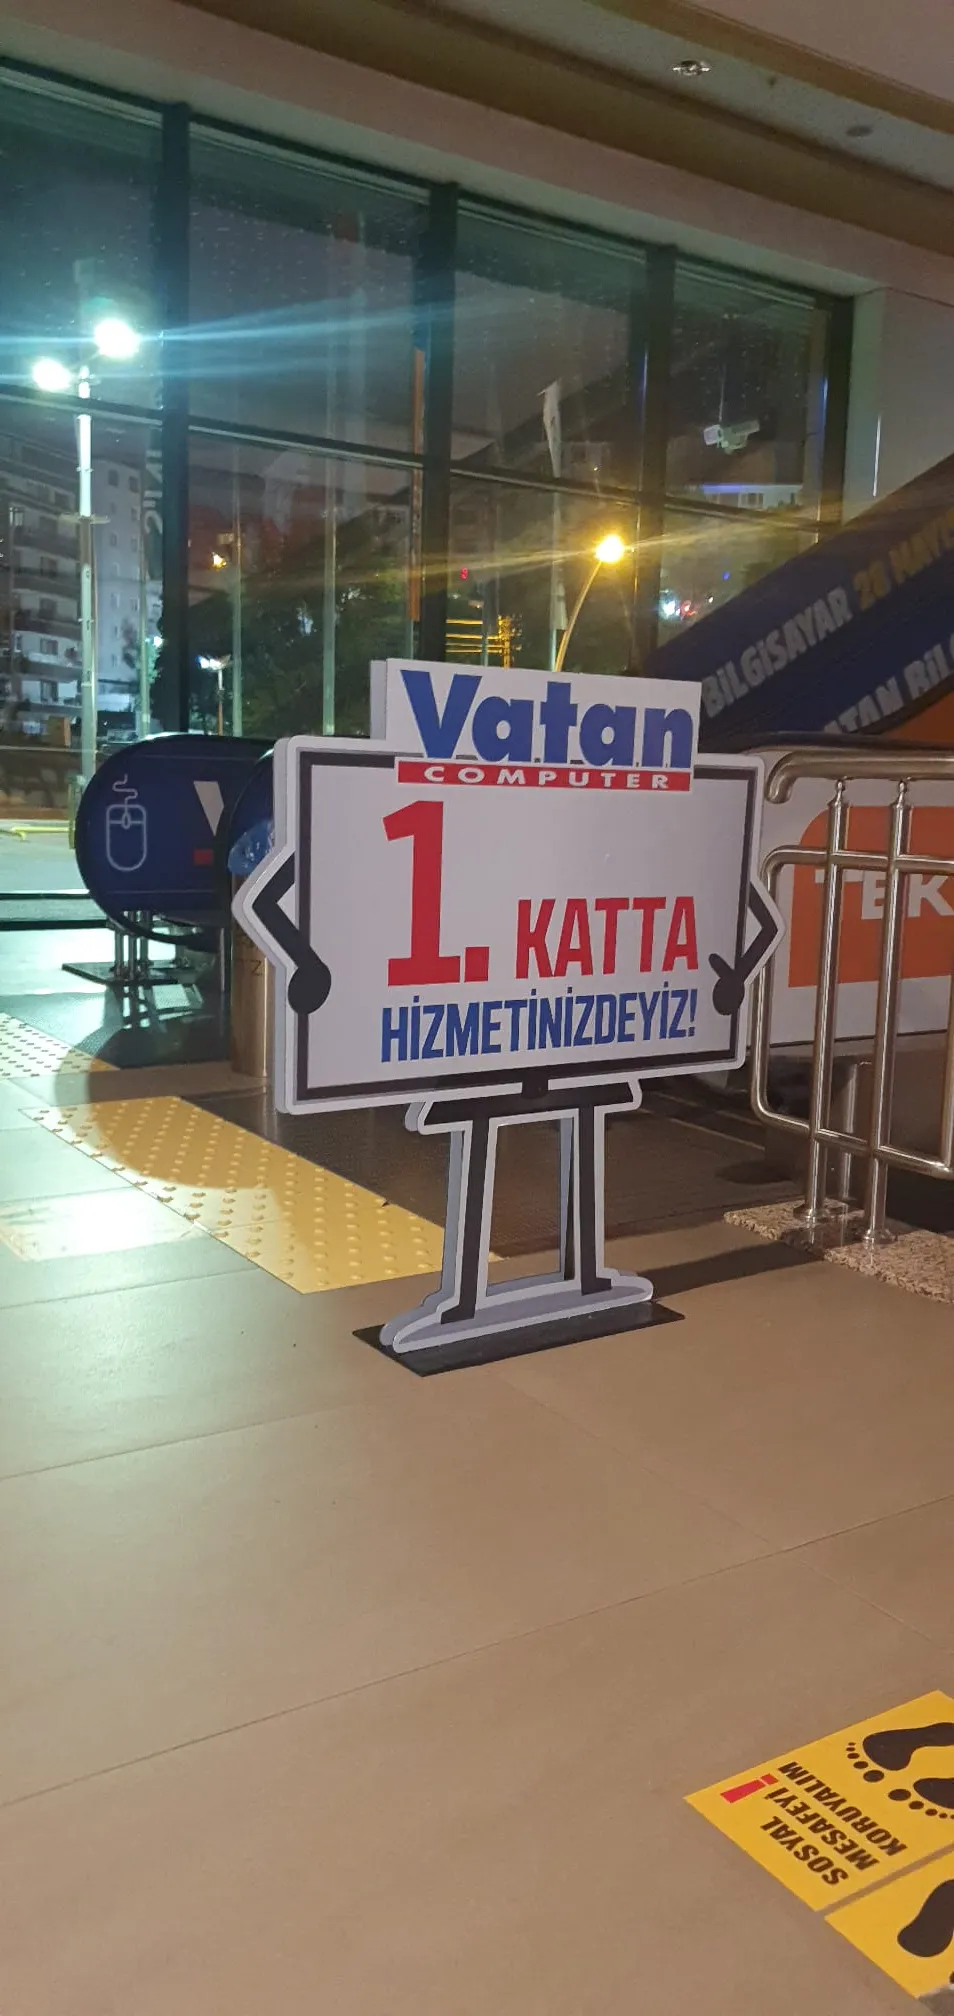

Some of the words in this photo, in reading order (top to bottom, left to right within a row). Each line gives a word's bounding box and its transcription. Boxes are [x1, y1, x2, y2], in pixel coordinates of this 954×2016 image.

[401, 669, 694, 768] Vatan
[423, 765, 670, 790] COMPUTER
[382, 800, 490, 987] 1.
[515, 896, 699, 980] KATTA
[381, 981, 698, 1063] HİZMETİNİZDEYİZ!
[760, 1815, 849, 1885] SOSYAL
[777, 1761, 908, 1856] KORUYALIM
